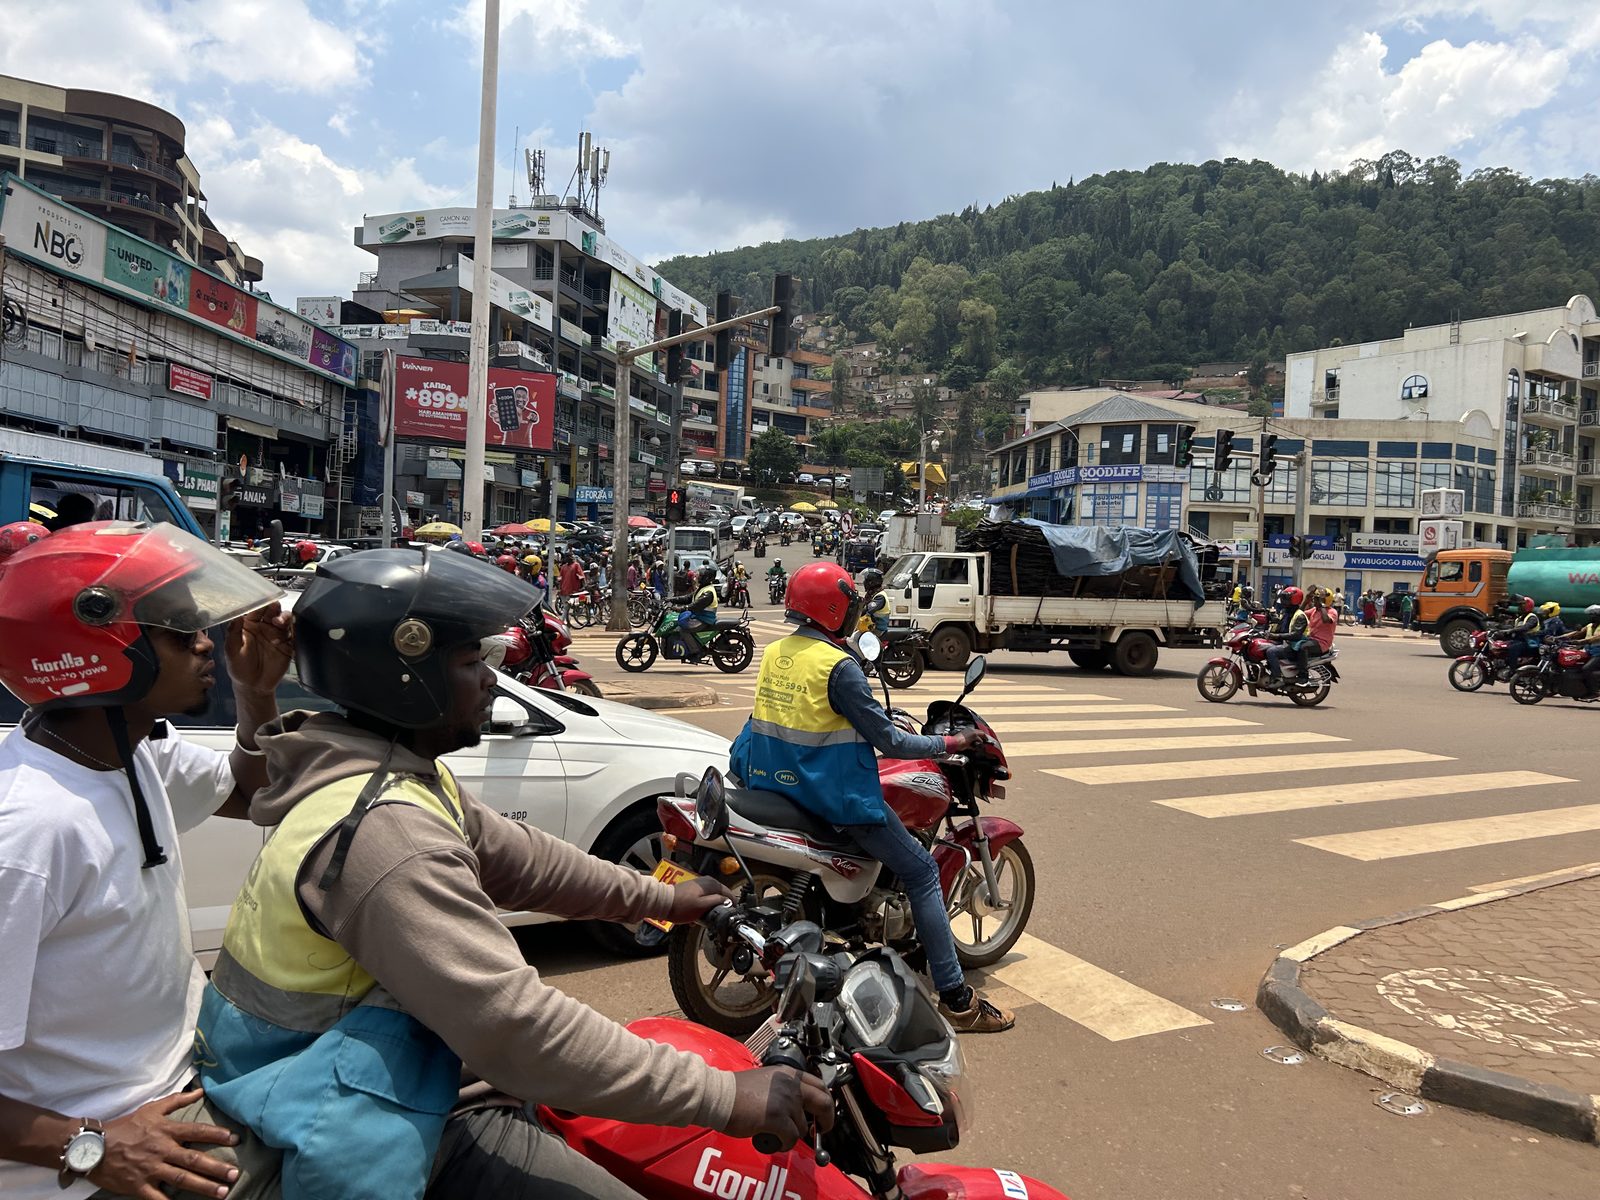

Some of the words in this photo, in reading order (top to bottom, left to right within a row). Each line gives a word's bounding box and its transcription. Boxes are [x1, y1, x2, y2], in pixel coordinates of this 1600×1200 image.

[34, 220, 82, 264] NBG
[117, 247, 153, 272] UNITED
[402, 361, 434, 372] WINNER
[423, 382, 451, 391] KANDA
[1079, 466, 1141, 478] GOODLIFE
[1393, 539, 1409, 547] PLC
[1312, 553, 1335, 561] KIGALI
[1351, 557, 1400, 566] NYABUGOGO
[79, 664, 108, 679] yawe
[511, 810, 528, 821] app
